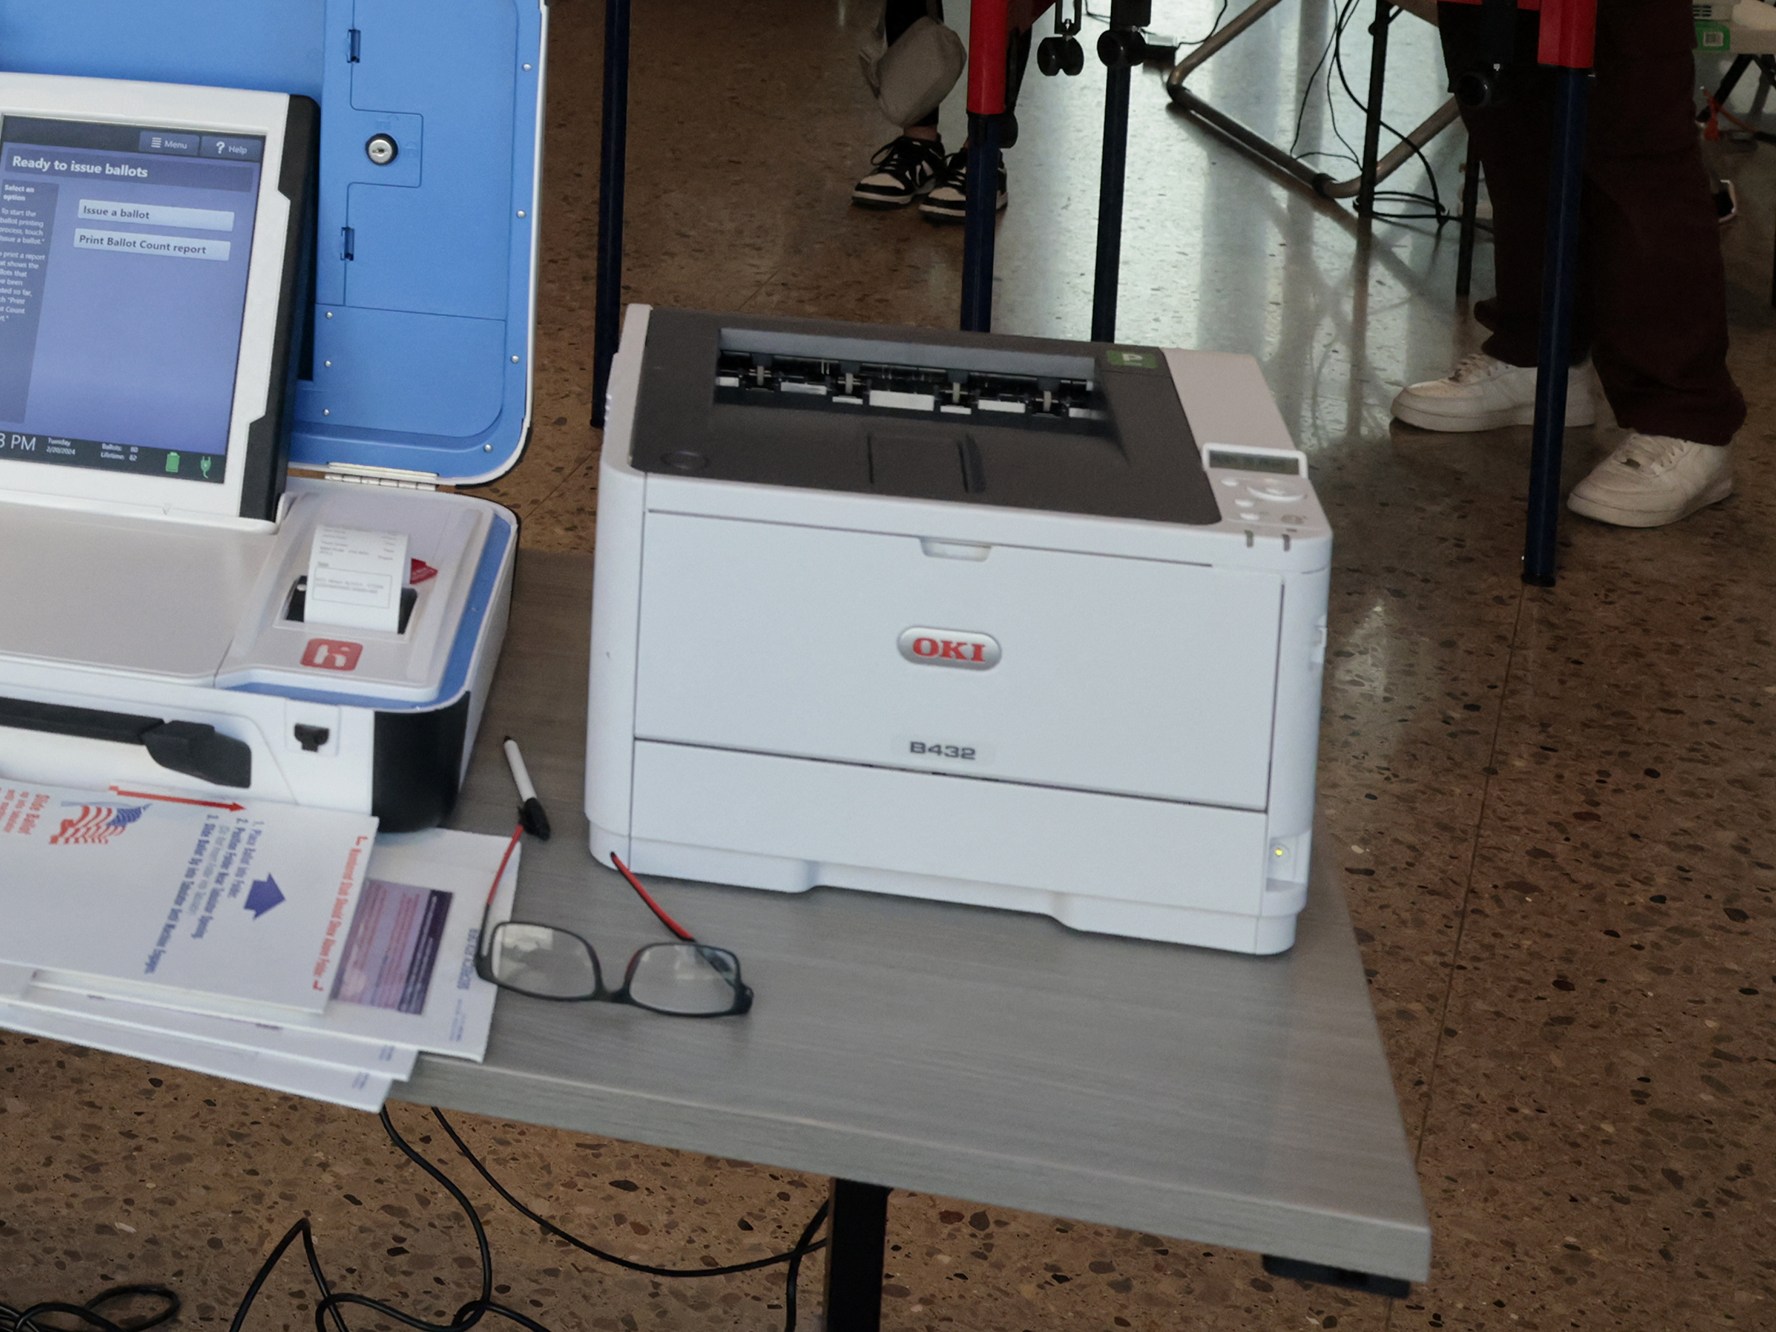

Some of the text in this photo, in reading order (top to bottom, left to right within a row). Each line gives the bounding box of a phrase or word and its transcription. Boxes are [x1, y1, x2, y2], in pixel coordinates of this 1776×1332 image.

[164, 140, 248, 156] Menu Help
[12, 155, 149, 178] Ready to issue ballots
[4, 184, 25, 192] Select
[3, 194, 26, 202] option
[1, 207, 9, 215] To
[83, 205, 150, 220] Issue a ballot
[0, 217, 44, 229] ballot printing
[78, 234, 207, 255] Print Ballot Count report
[25, 253, 46, 261] report
[14, 270, 28, 278] that
[6, 278, 24, 286] been
[5, 306, 26, 314] Count
[10, 433, 37, 452] PM
[912, 637, 986, 663] OKI
[909, 740, 976, 761] B432
[245, 829, 262, 846] Place
[240, 847, 256, 865] Ballot
